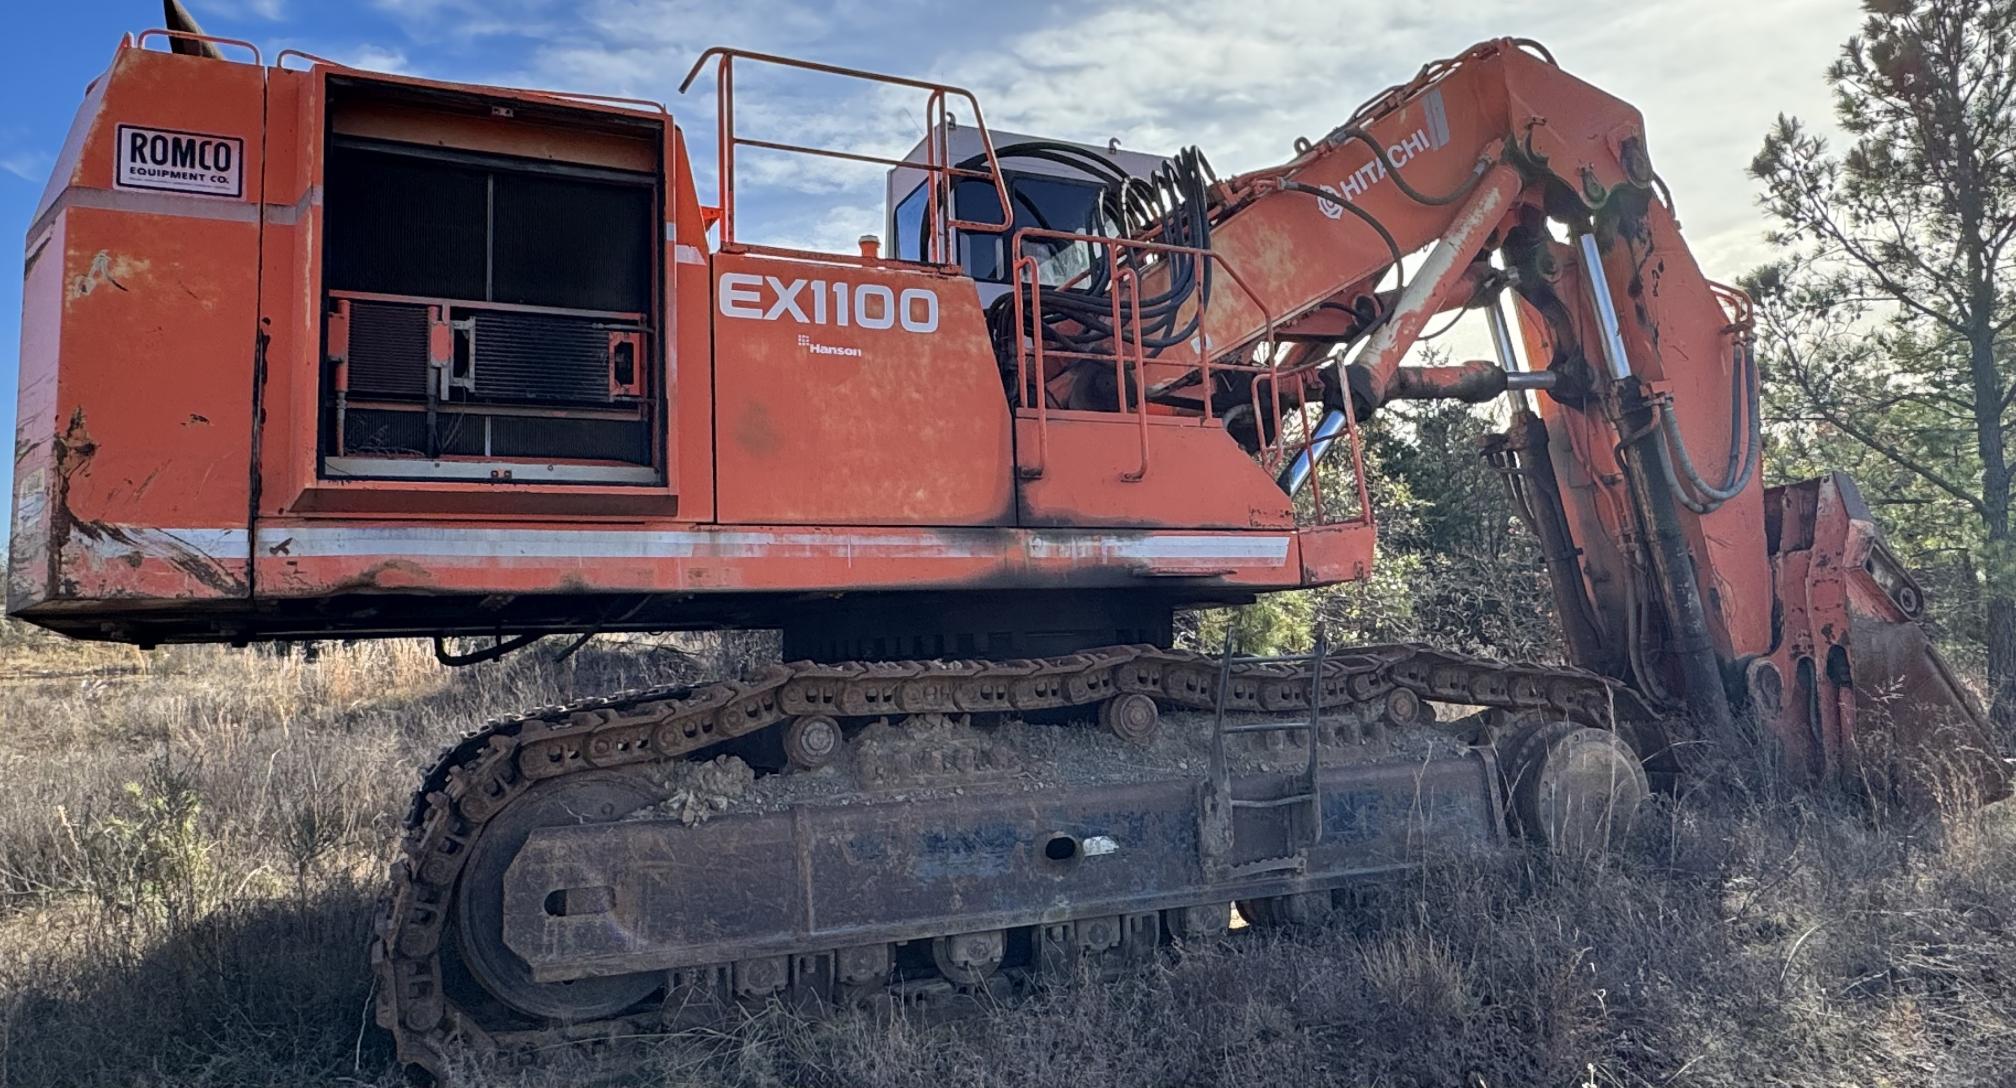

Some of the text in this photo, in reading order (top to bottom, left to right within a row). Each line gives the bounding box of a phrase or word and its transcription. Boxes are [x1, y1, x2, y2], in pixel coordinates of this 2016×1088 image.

[131, 132, 231, 172] ROMCO
[130, 166, 205, 182] EQUIPMENT
[210, 175, 229, 184] CO.
[719, 272, 938, 333] EX1100
[809, 343, 862, 356] Hanson
